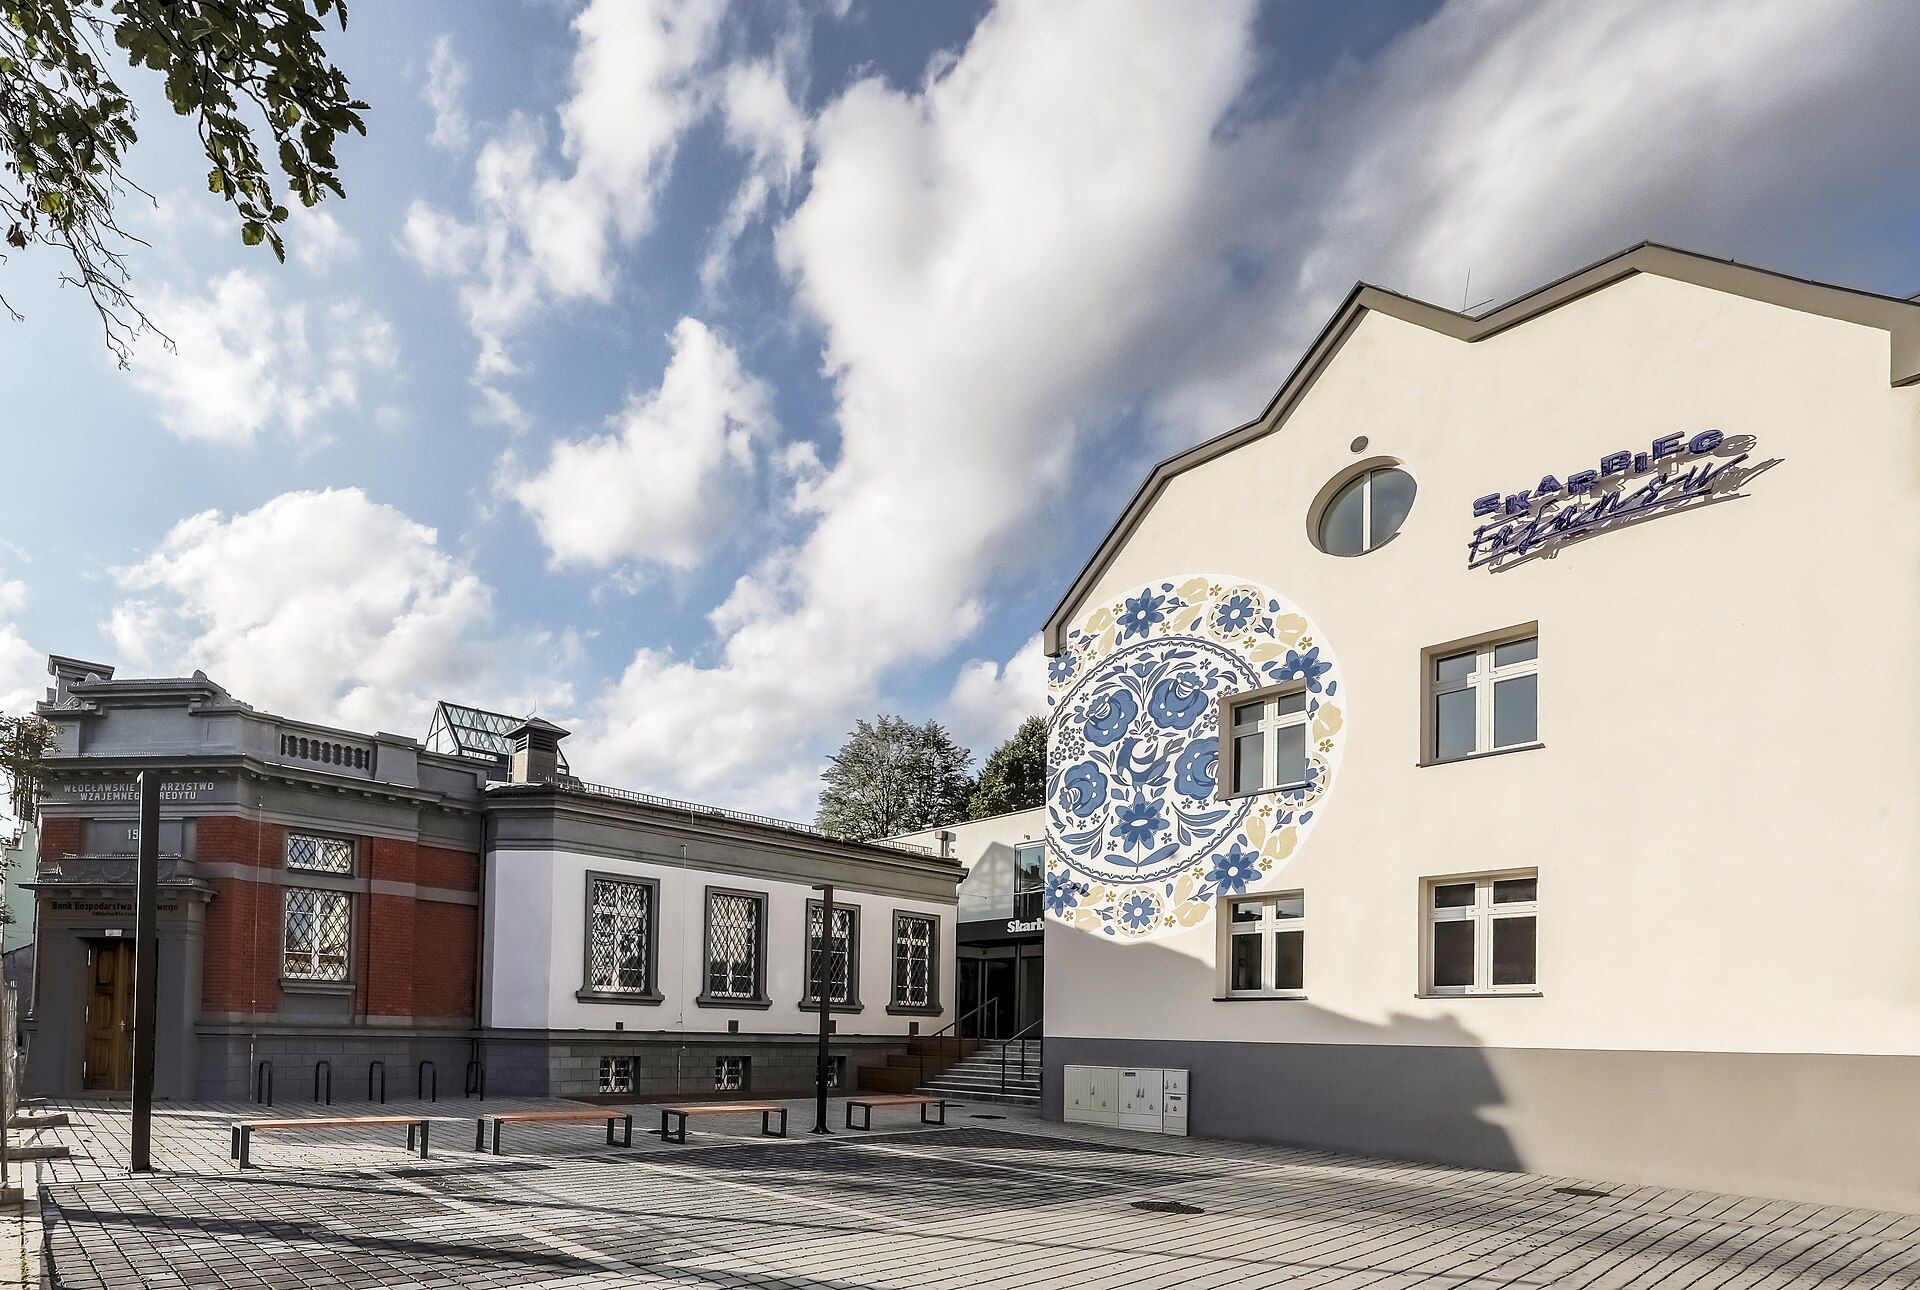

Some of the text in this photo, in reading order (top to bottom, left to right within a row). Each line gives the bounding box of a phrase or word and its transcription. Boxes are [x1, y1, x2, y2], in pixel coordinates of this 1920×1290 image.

[1473, 429, 1724, 517] SKARBIEC
[64, 782, 215, 793] WŁOCŁAWSKIE ARZYSTWO
[80, 791, 197, 801] WZAJEMNEG REDYTU
[127, 829, 139, 840] 19
[52, 901, 73, 910] Bank
[74, 901, 133, 912] Gospodarstwa
[1006, 917, 1045, 933] Skarb
